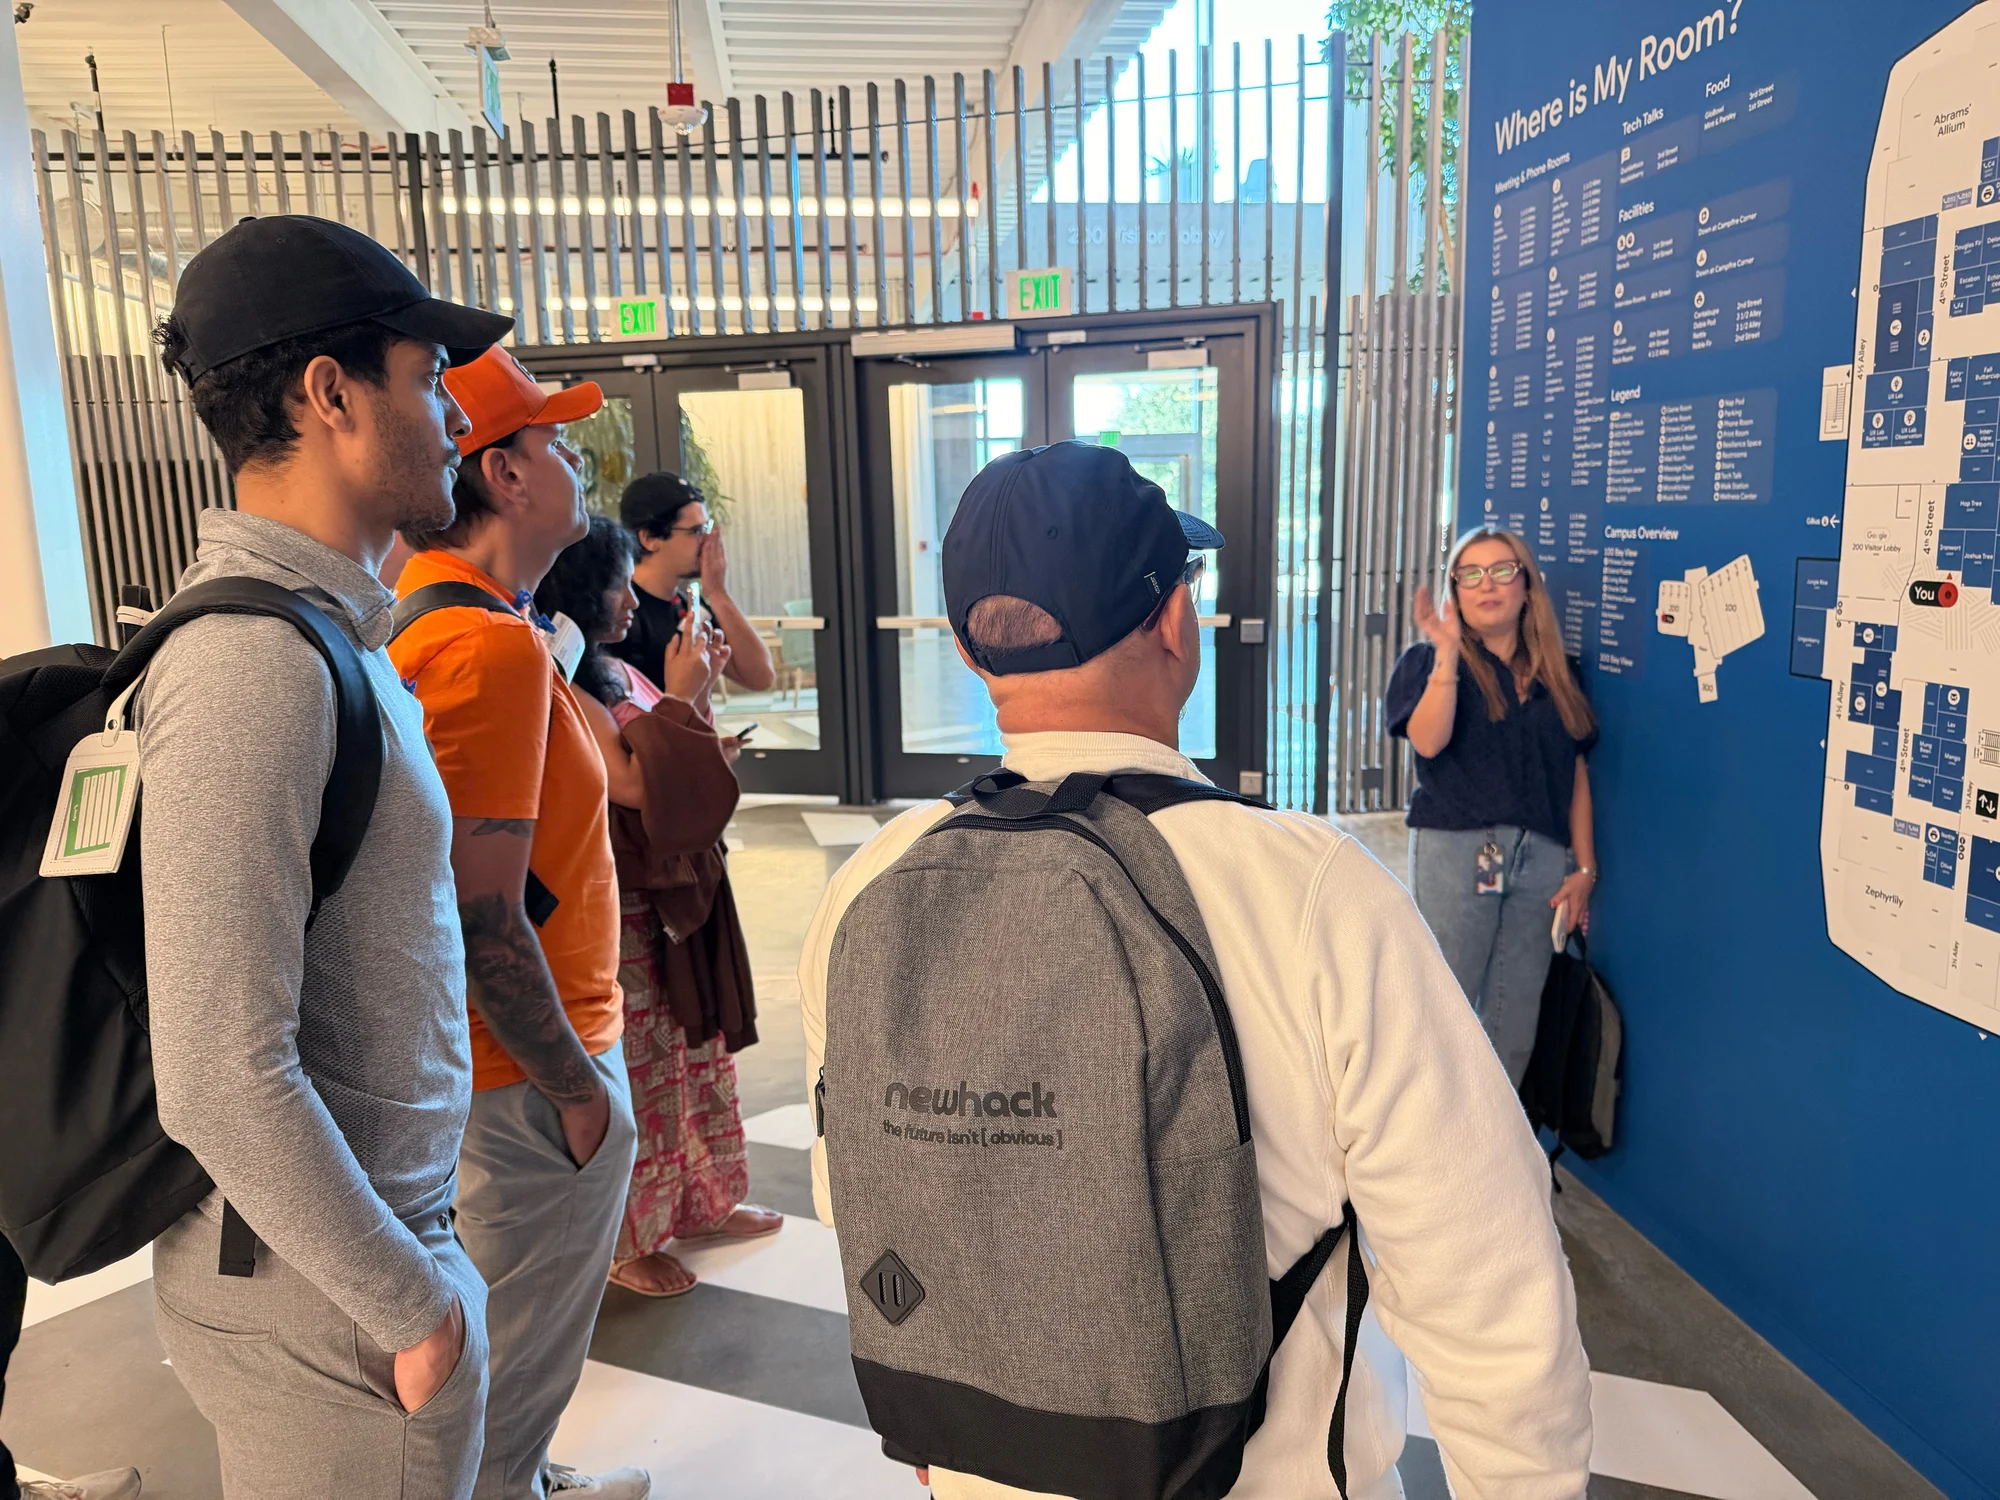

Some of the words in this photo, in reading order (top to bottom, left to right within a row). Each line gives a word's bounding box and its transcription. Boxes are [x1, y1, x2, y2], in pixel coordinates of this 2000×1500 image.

[1495, 98, 1563, 155] Where
[1568, 79, 1587, 118] is
[1593, 55, 1633, 105] My
[1639, 0, 1744, 81] Room?
[1705, 73, 1731, 98] Food
[1749, 90, 1758, 101] 3rd
[1758, 83, 1774, 97] Street
[1748, 102, 1757, 112] 1st
[1757, 96, 1773, 108] Street
[1622, 116, 1642, 135] Tech
[1643, 108, 1664, 126] Talks
[1934, 103, 1972, 126] Abrams'
[1937, 121, 1966, 137] Allium
[1495, 175, 1520, 194] Meeting
[1526, 163, 1547, 180] Phone
[1547, 152, 1570, 170] Rooms
[1618, 201, 1655, 223] Facilities
[1717, 218, 1740, 230] Campfire
[1739, 212, 1758, 224] Corner
[1954, 242, 1975, 252] Douglas
[1715, 261, 1737, 272] Campfire
[1736, 256, 1755, 267] Corner
[1940, 254, 1951, 288] Street
[1019, 274, 1061, 311] EXIT
[1746, 298, 1763, 308] Street
[619, 301, 656, 335] EXIT
[1745, 331, 1760, 341] Street
[1859, 338, 1868, 363] Alley
[1610, 386, 1641, 404] Legend
[1739, 418, 1754, 426] Room
[1735, 429, 1749, 437] Room
[1924, 500, 1935, 536] Street
[1604, 525, 1637, 542] Campus
[1637, 525, 1679, 540] Overview
[1852, 543, 1864, 551] 200
[1865, 543, 1882, 551] Visitor
[1883, 544, 1902, 553] Lobby
[1964, 552, 1981, 560] Joshua
[1914, 586, 1935, 601] You
[1837, 680, 1846, 704] Alley
[1901, 728, 1910, 758] Street
[1944, 752, 1961, 762] Mango
[1967, 780, 1975, 797] Alley
[1940, 861, 1953, 871] Olive
[1865, 884, 1904, 908] Zephyrlily
[884, 1080, 1058, 1118] newhack
[883, 1120, 902, 1137] the
[904, 1124, 945, 1143] future
